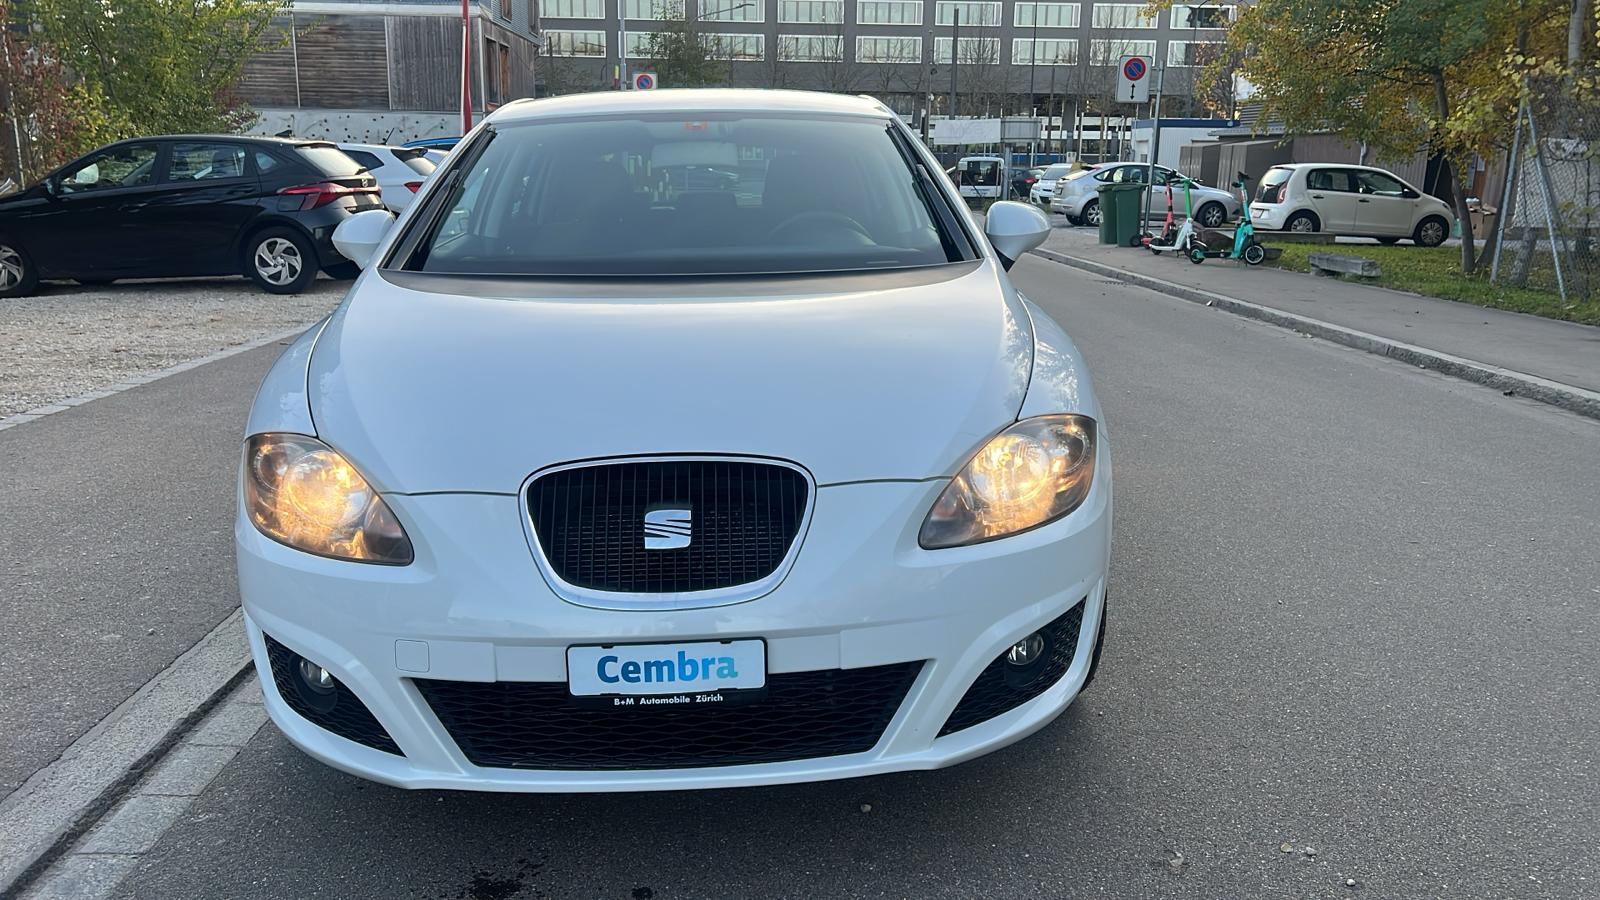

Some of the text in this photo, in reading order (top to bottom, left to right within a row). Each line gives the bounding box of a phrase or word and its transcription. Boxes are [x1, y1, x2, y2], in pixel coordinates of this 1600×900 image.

[597, 650, 738, 683] Cembra
[614, 693, 724, 706] B+M Automobile Zürich
